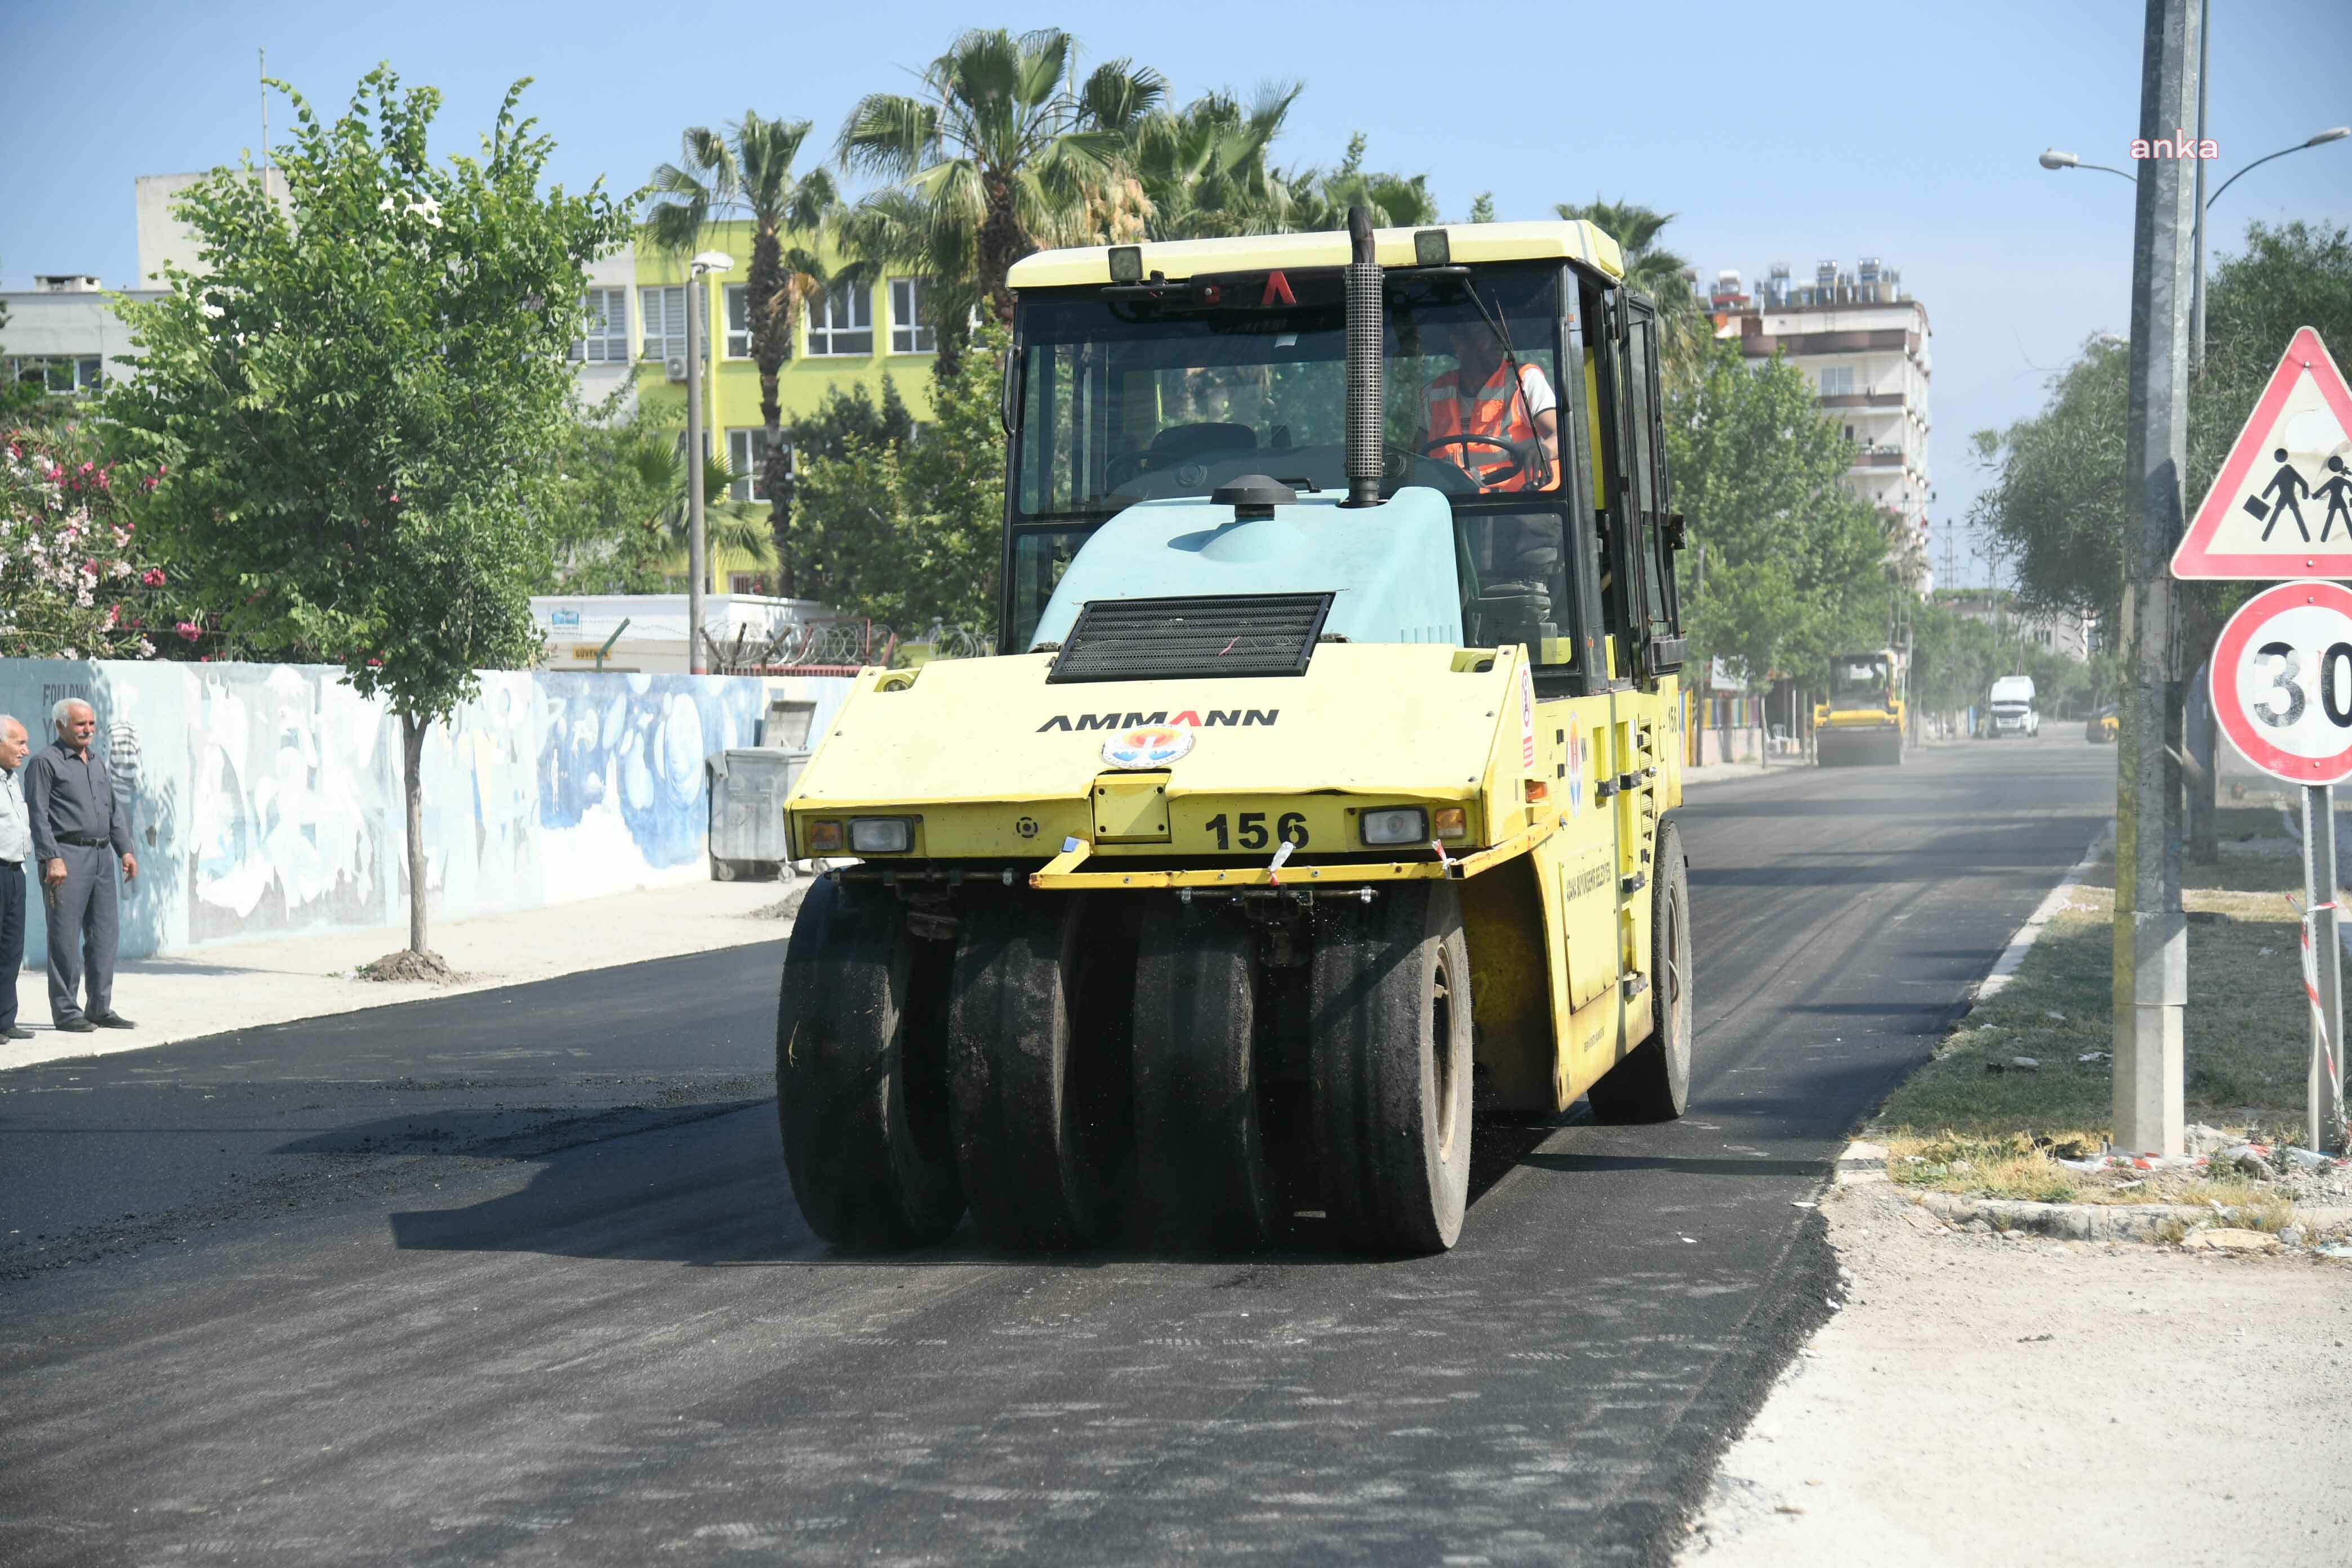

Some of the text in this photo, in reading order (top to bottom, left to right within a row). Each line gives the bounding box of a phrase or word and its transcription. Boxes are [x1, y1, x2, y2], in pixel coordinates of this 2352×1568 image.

[2254, 642, 2352, 728] 30
[1035, 709, 1280, 732] AMMANN
[1669, 706, 1677, 734] 156
[1205, 812, 1309, 850] 156
